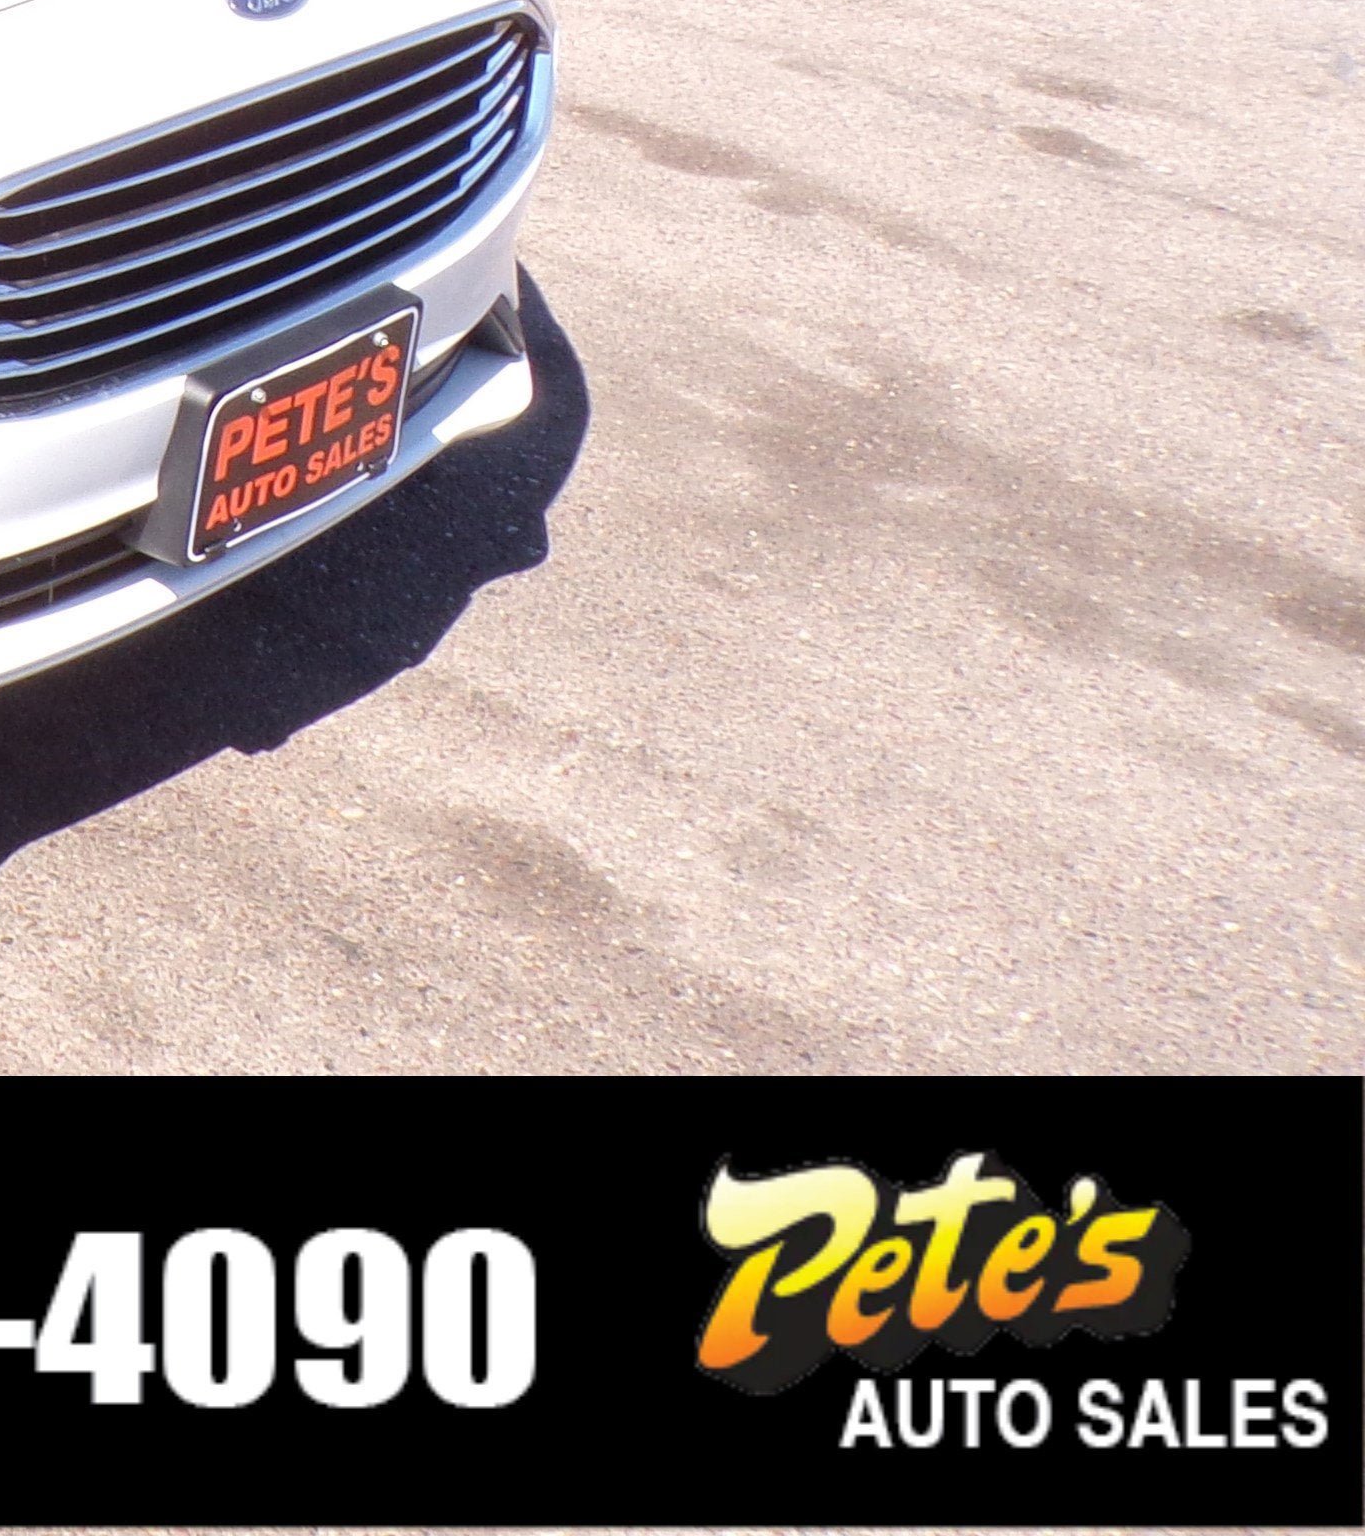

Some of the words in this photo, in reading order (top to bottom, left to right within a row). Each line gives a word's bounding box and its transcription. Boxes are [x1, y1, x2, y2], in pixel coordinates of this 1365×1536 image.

[205, 464, 298, 531] AUTO
[305, 413, 393, 485] SALES
[213, 344, 401, 482] PETE'S
